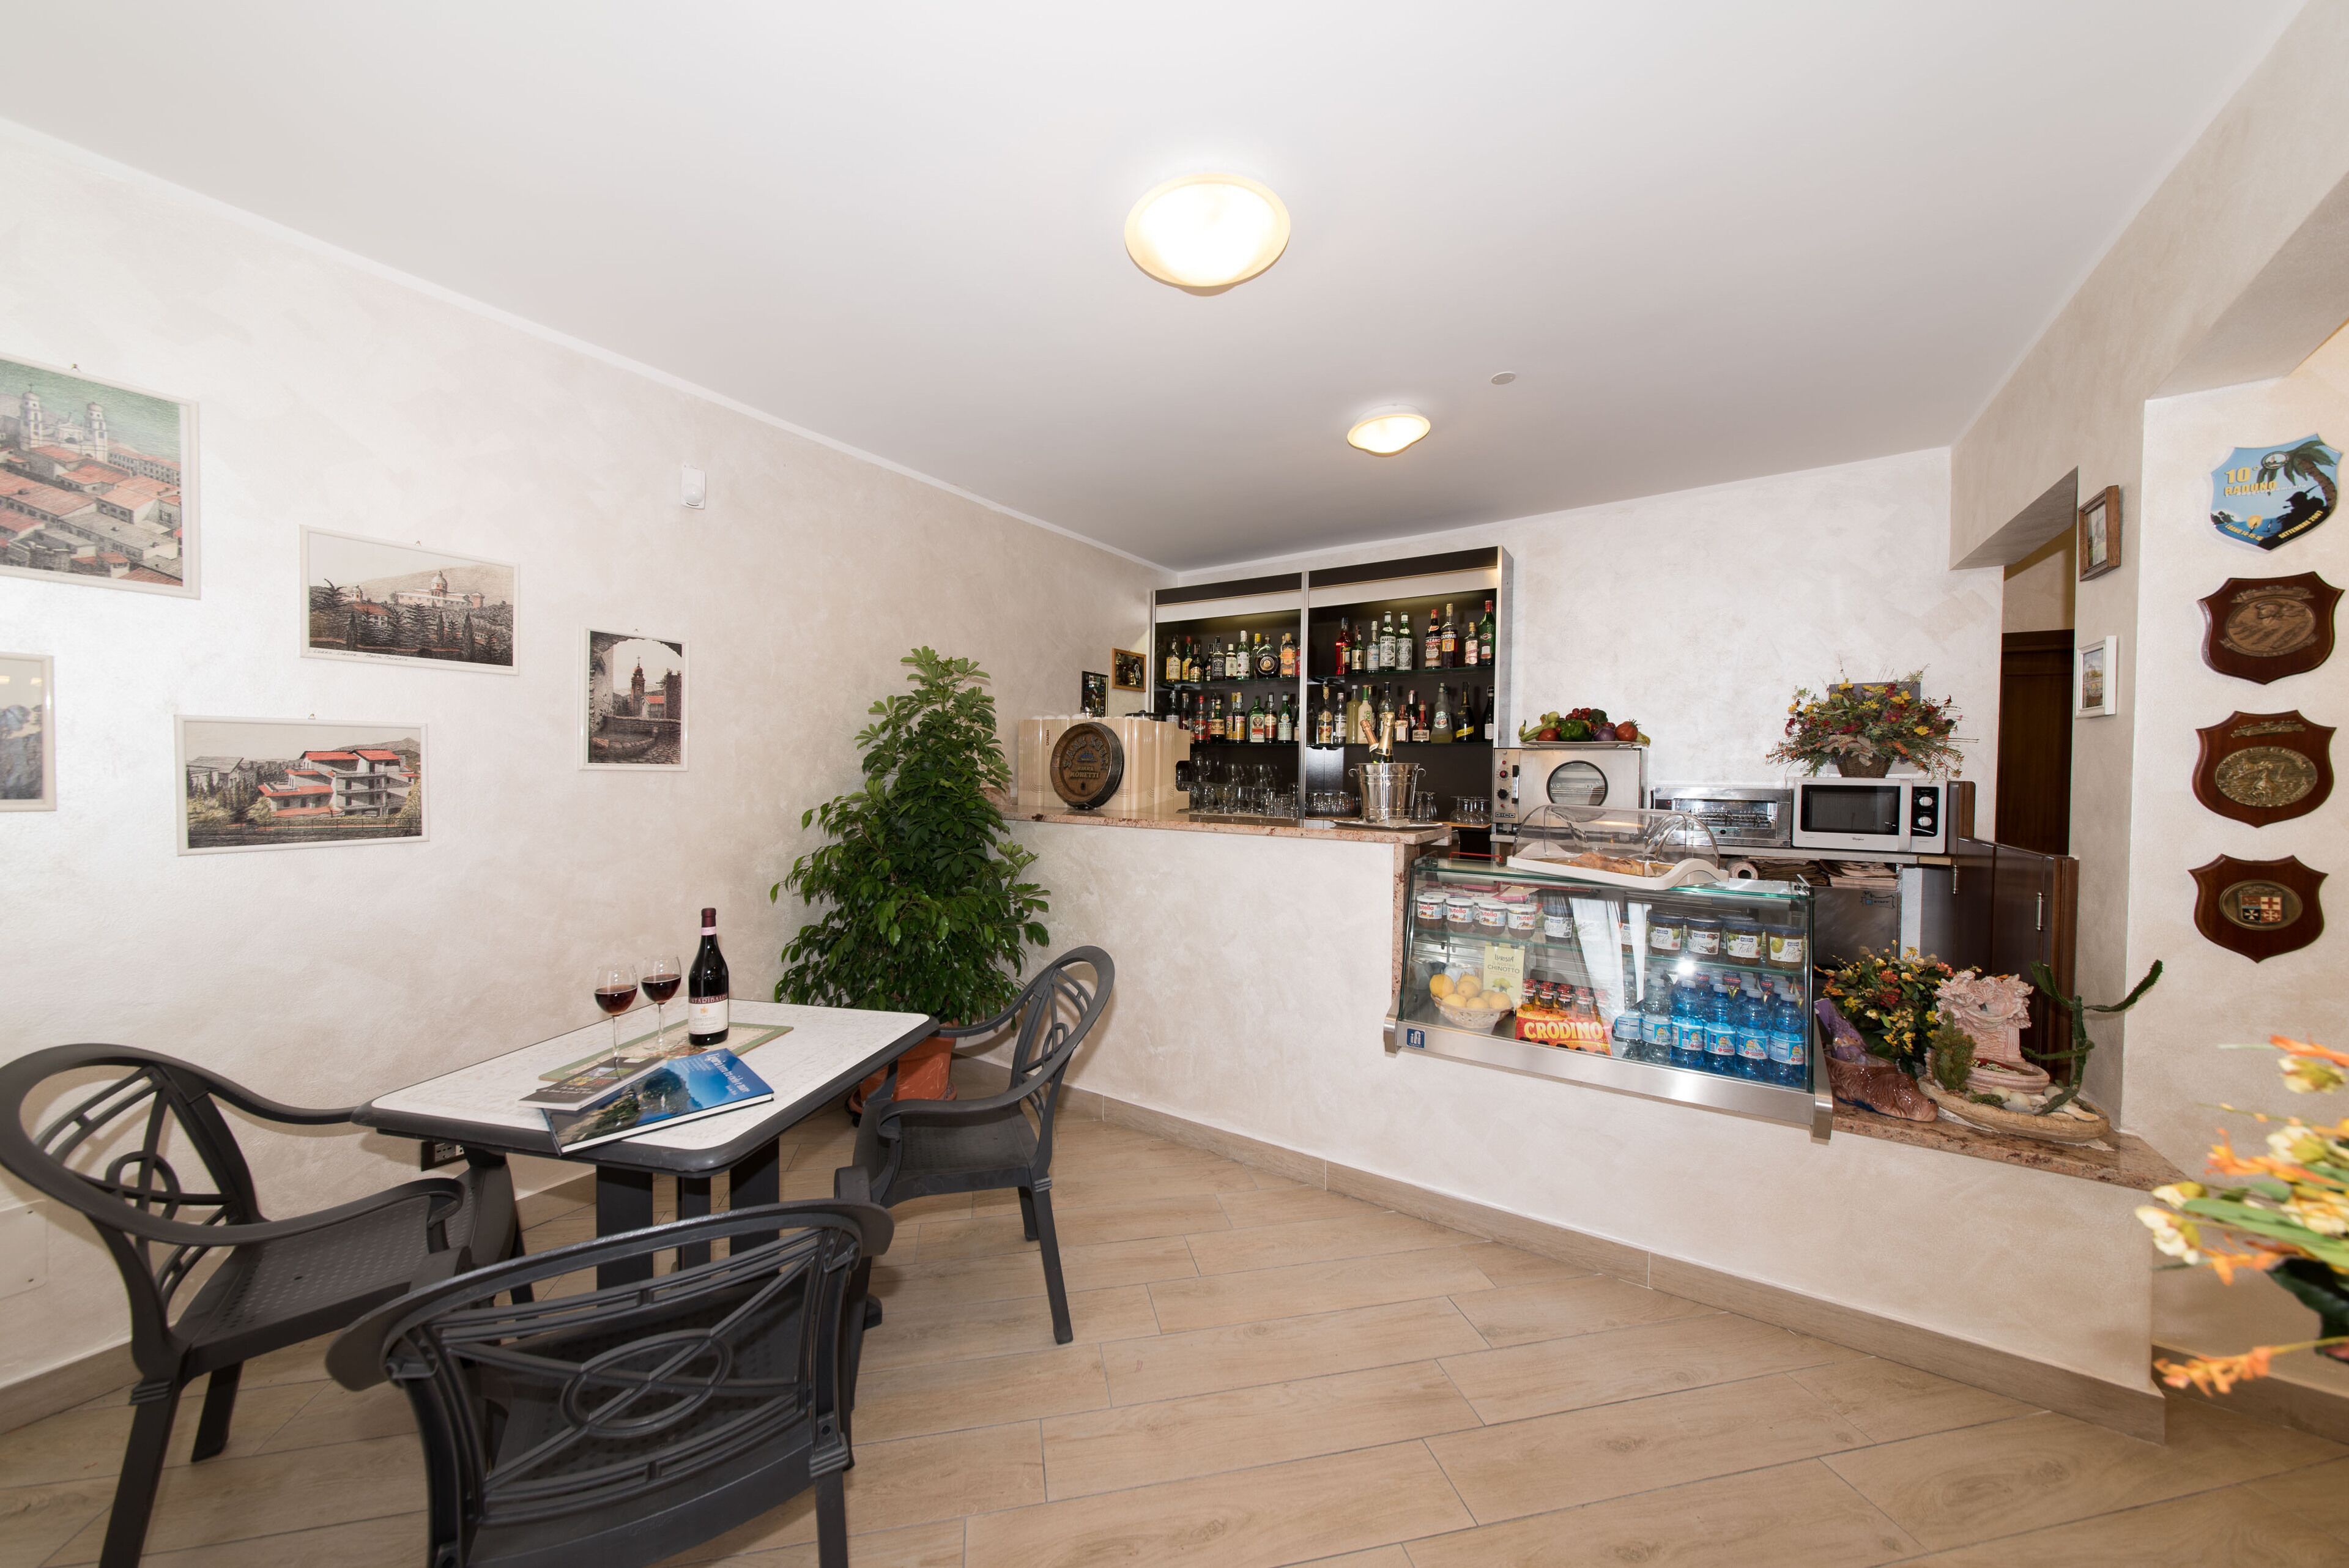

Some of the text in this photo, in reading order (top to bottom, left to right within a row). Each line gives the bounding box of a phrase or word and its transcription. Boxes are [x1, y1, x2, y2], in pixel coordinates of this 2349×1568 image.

[2225, 480, 2277, 497] RADUNO
[2278, 519, 2310, 538] SETTEMBRE
[1062, 737, 1086, 768] SANS
[1091, 735, 1108, 770] SOUCI
[1494, 954, 1514, 962] LURISIA
[1487, 965, 1520, 974] CHINOTTO
[1524, 1022, 1604, 1039] CRODINO
